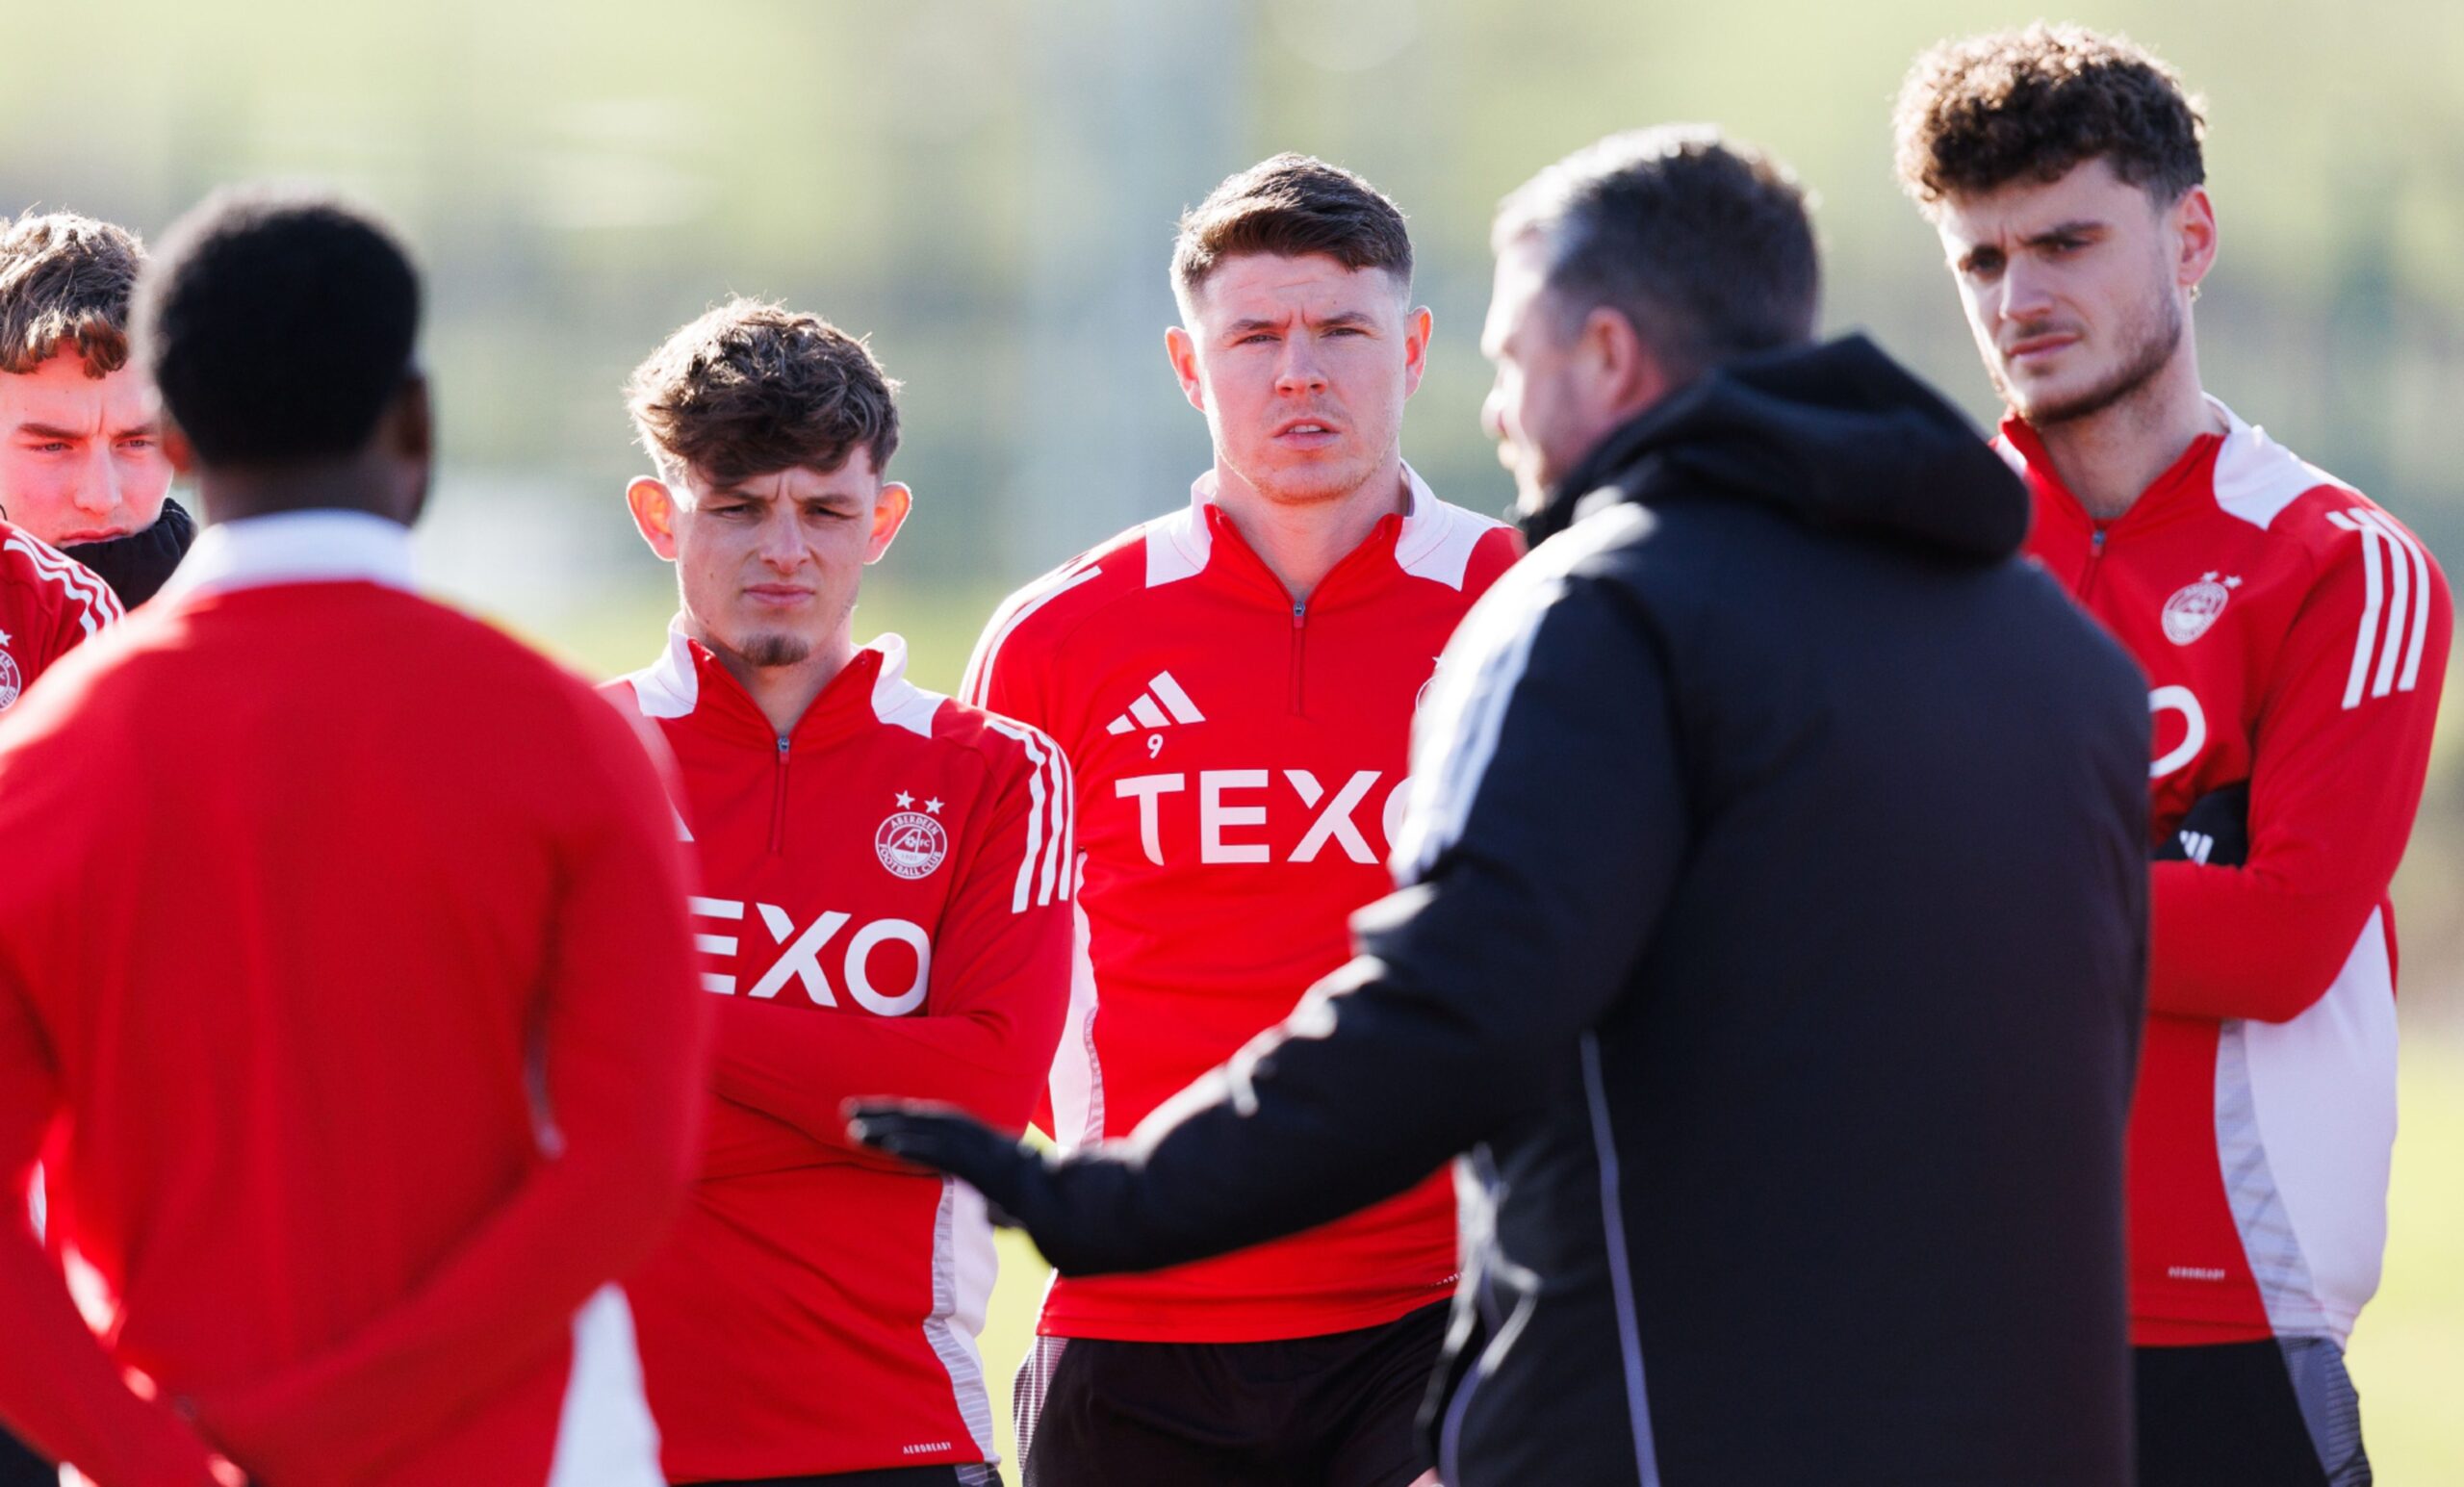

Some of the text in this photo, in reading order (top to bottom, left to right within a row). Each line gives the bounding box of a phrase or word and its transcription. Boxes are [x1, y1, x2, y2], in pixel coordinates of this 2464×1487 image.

[1146, 733, 1164, 759] 9
[890, 814, 940, 835] ABERDEEN
[878, 843, 942, 876] FOOTBALL CLUB
[686, 895, 932, 1017] EXO
